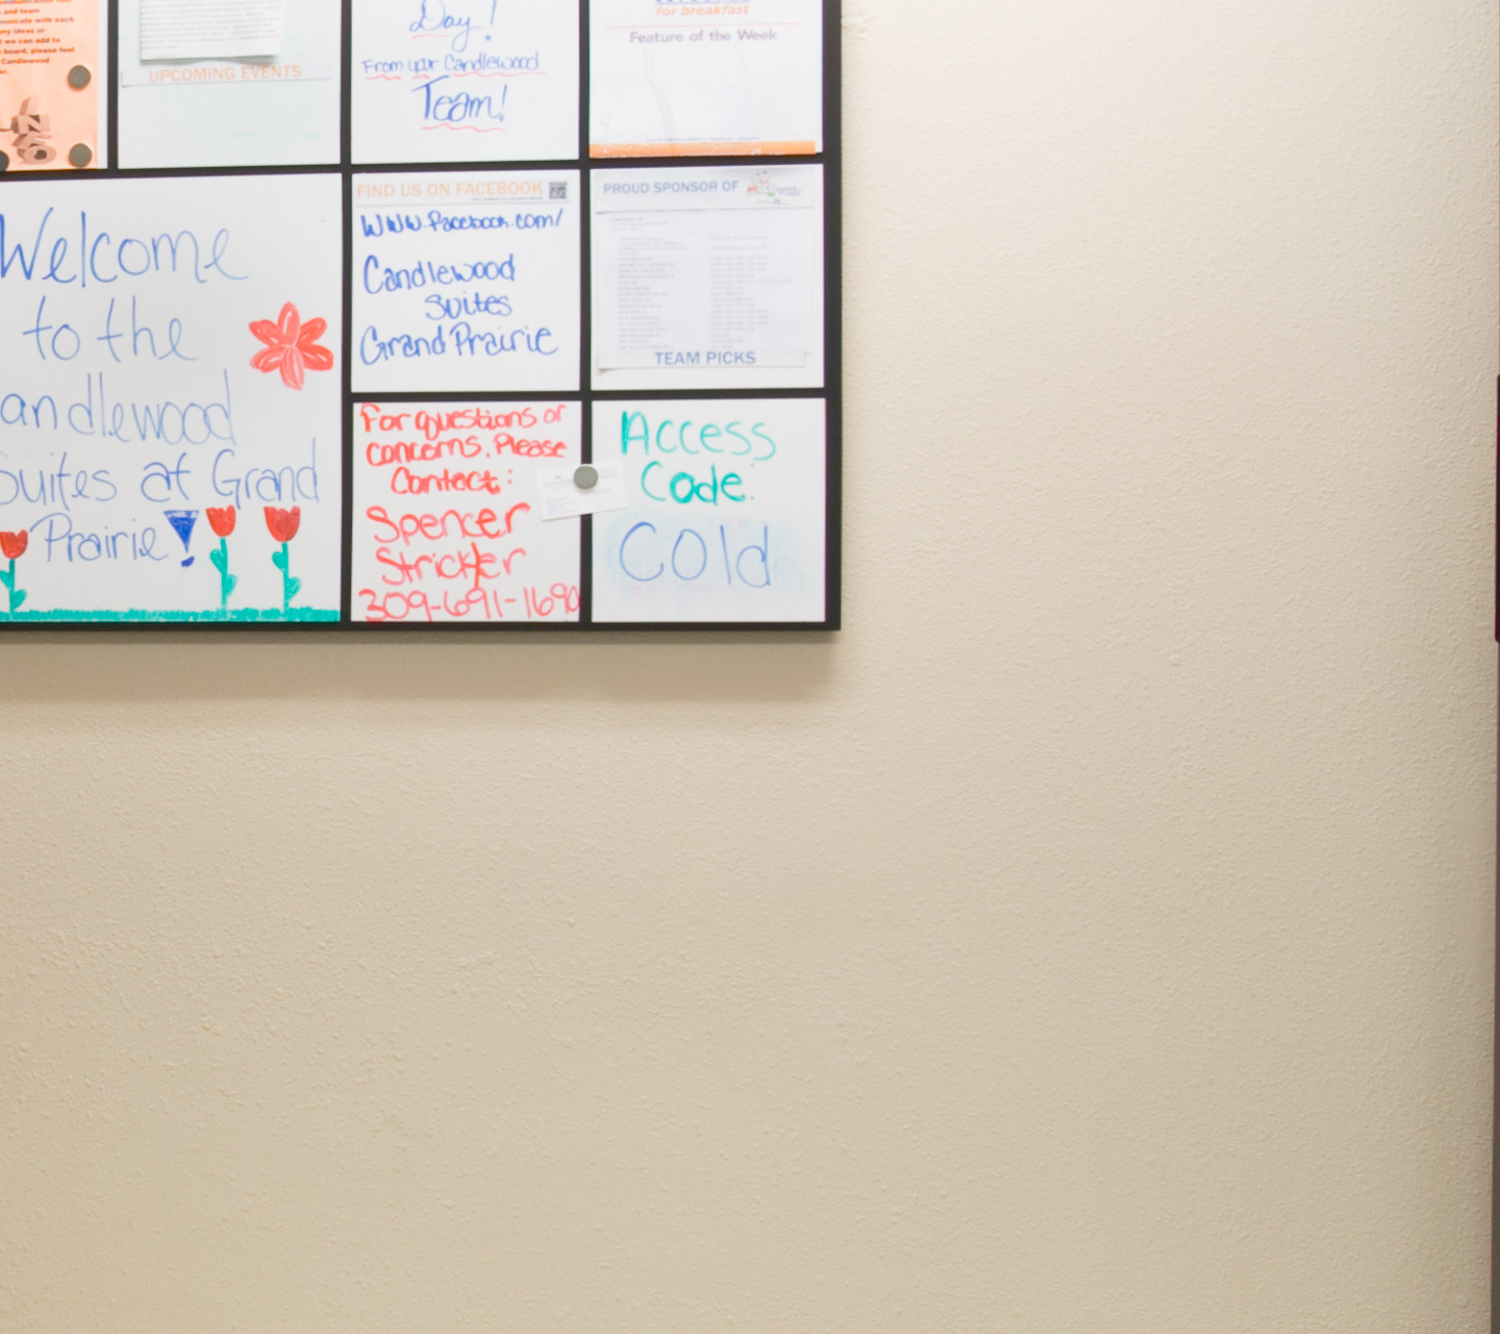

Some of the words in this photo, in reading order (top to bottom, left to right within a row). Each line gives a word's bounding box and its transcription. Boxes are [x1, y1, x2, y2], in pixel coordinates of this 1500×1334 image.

[656, 7, 675, 16] for
[681, 5, 749, 16] breakfast
[630, 31, 684, 44] Feature
[690, 30, 703, 42] of
[709, 30, 731, 41] the
[738, 29, 777, 41] Week
[149, 68, 236, 83] UPCOMING
[242, 65, 302, 79] EVENTS
[444, 51, 539, 72] Candlewood
[411, 75, 508, 122] Team!
[357, 184, 395, 198] FIND
[400, 184, 422, 197] US
[427, 183, 450, 196] ON
[456, 181, 543, 195] FACEBOOK
[604, 183, 649, 194] PROUD
[653, 181, 718, 193] SPONSOR
[722, 181, 738, 191] OF
[0, 207, 248, 287] Welcome
[363, 254, 515, 294] Candlewood
[22, 296, 80, 361] to
[97, 296, 199, 362] the
[361, 325, 446, 365] Grand
[450, 322, 558, 356] Prairie
[655, 352, 700, 365] TEAM
[706, 351, 756, 364] PICKS
[415, 407, 537, 441] questions
[544, 405, 566, 424] or
[621, 411, 776, 460] Access
[494, 433, 566, 457] Please
[141, 453, 191, 502] at
[212, 438, 320, 509] Grand
[366, 502, 530, 546] Spencer
